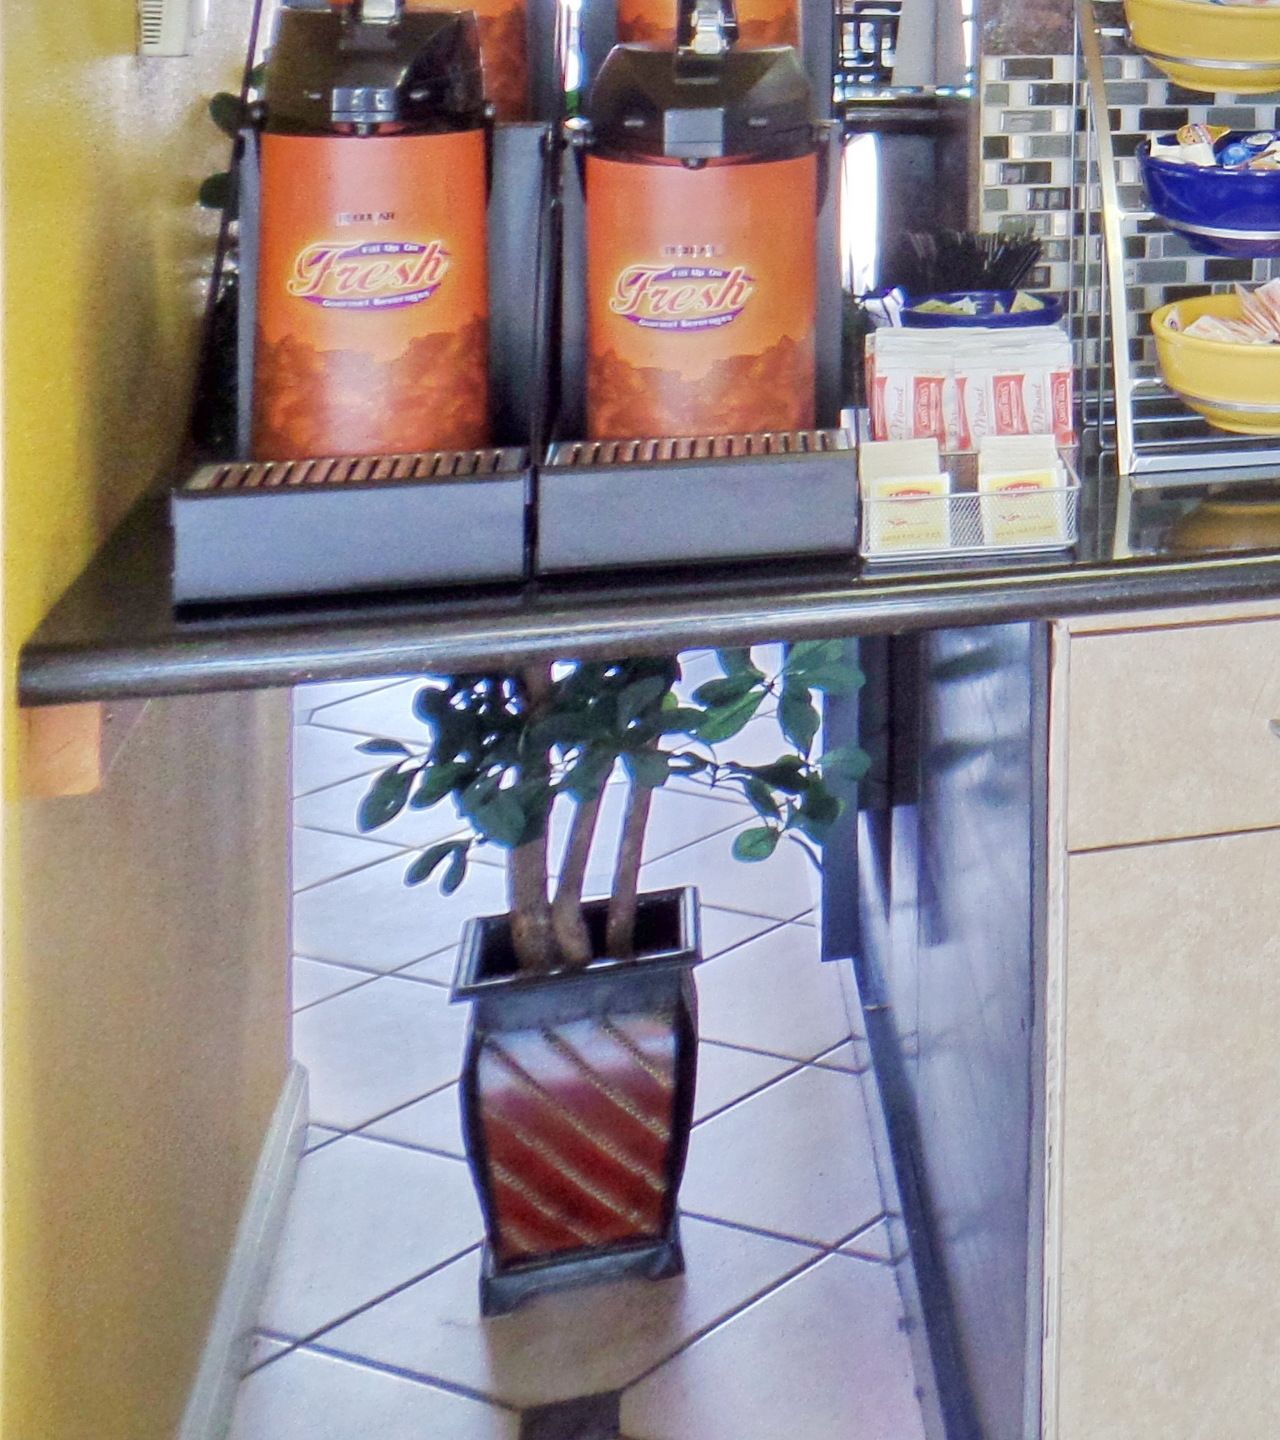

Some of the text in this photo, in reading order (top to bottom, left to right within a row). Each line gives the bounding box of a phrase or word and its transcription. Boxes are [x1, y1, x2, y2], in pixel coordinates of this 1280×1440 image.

[361, 243, 419, 254] Fill Up On
[286, 240, 449, 297] Fresh
[691, 269, 705, 278] Up
[708, 269, 723, 277] On
[608, 264, 753, 315] Fresh
[373, 290, 431, 307] Beverages
